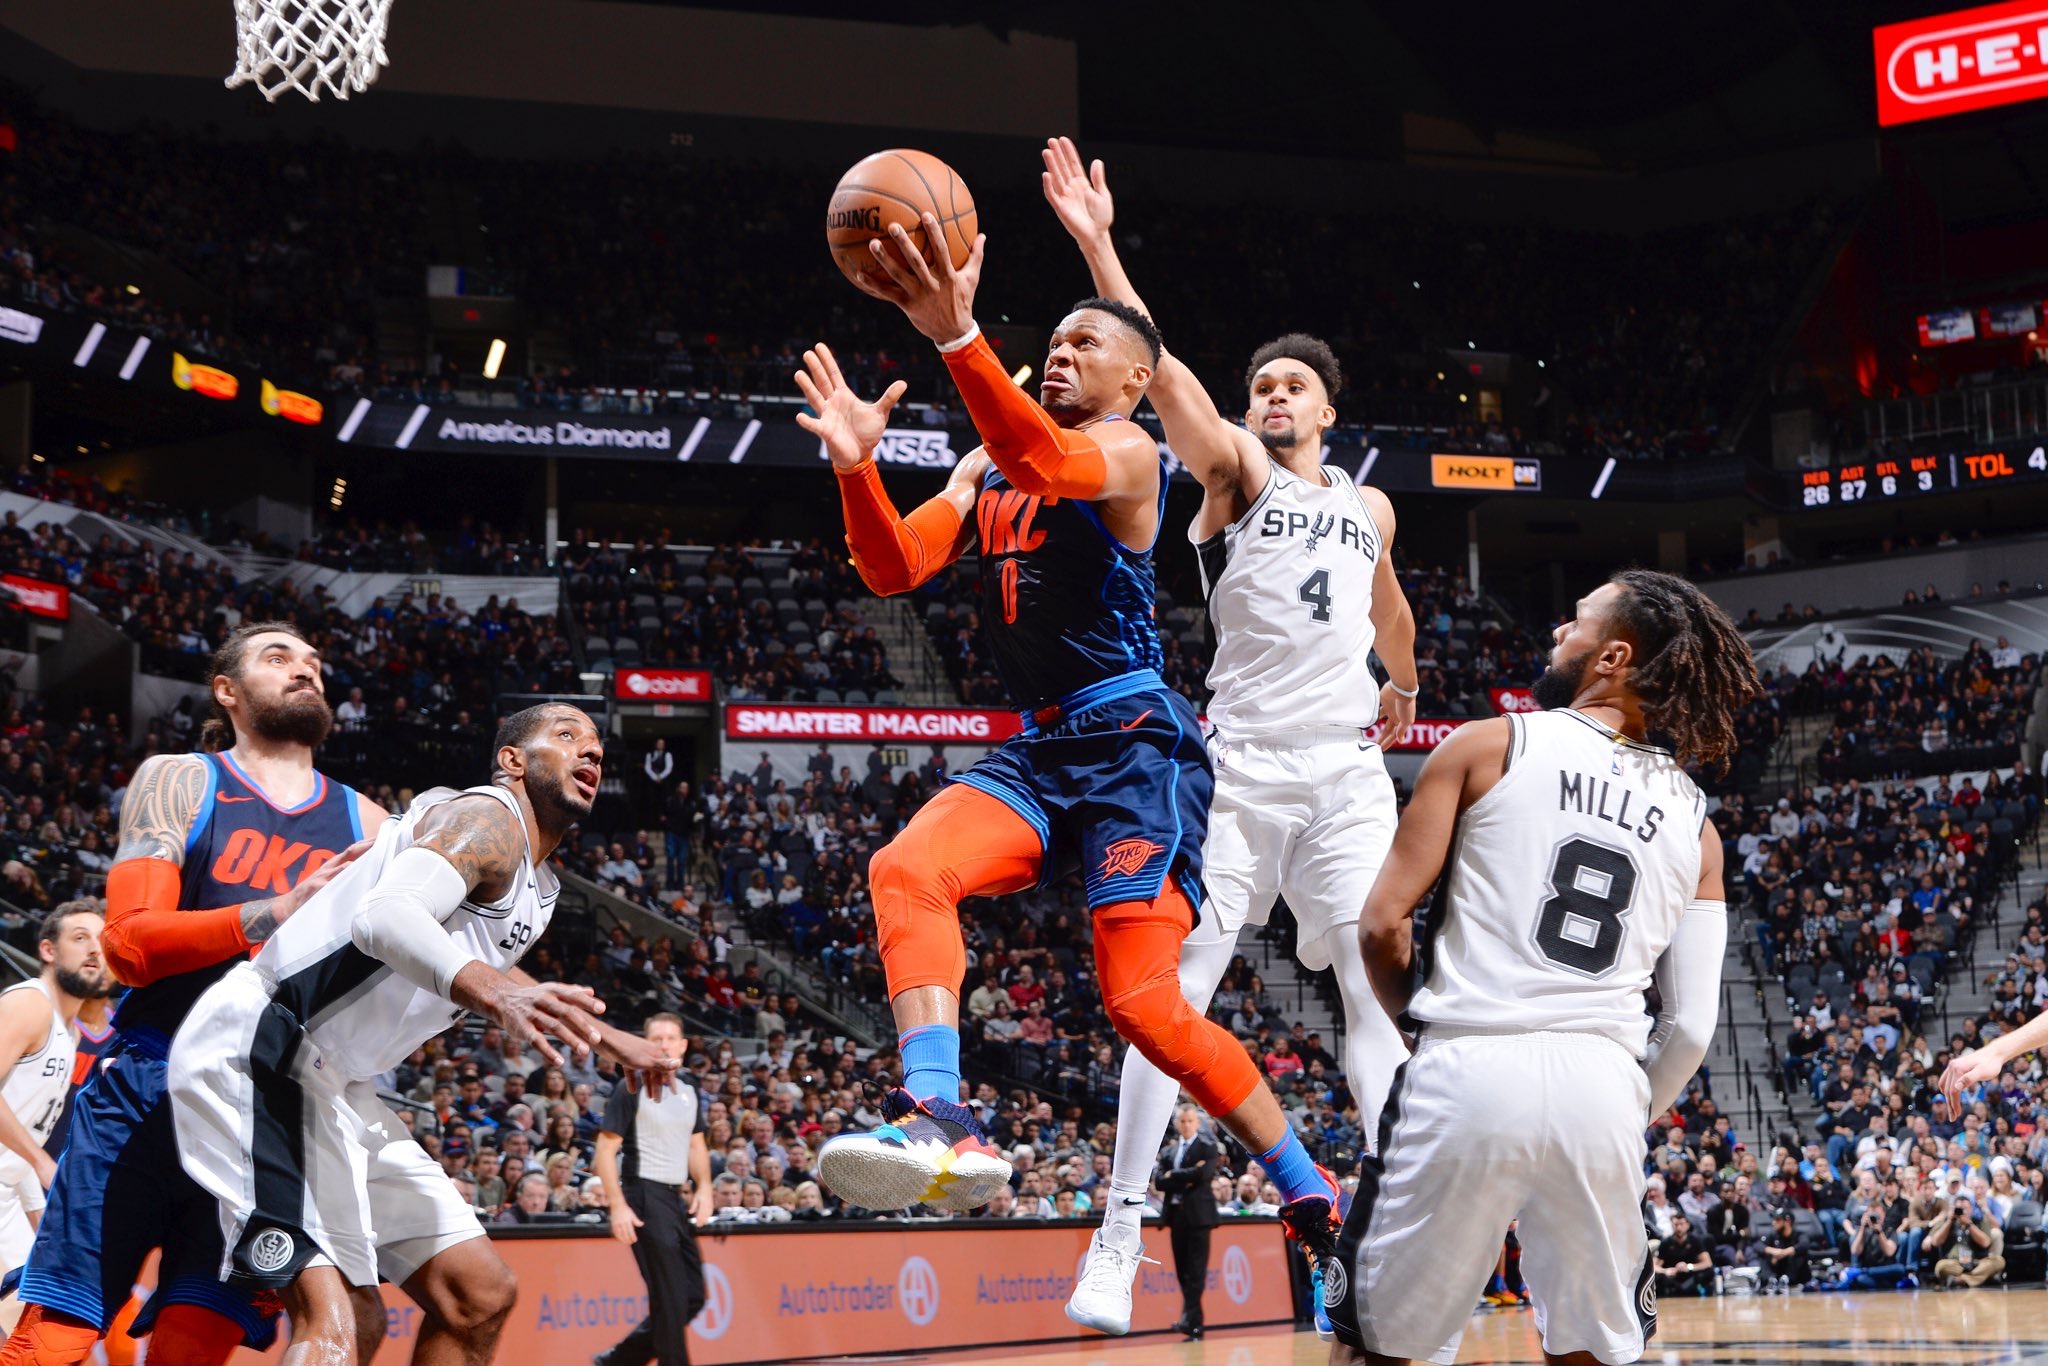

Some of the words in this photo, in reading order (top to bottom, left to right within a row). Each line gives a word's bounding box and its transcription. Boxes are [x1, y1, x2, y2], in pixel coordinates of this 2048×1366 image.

[438, 418, 554, 445] Americus
[556, 422, 671, 450] Diamond
[1447, 465, 1506, 479] HOLT
[1910, 456, 1937, 472] BLK
[1963, 452, 2015, 480] TOL
[2027, 446, 2047, 471] 4
[1803, 484, 1831, 506] 26
[1840, 479, 1867, 501] 27
[1881, 475, 1897, 496] 6
[1917, 471, 1933, 491] 3
[977, 489, 1060, 557] OKC
[1260, 509, 1375, 563] SPURS
[1001, 558, 1018, 625] 0
[1297, 566, 1334, 626] 4
[736, 710, 863, 734] SMARTER
[868, 712, 991, 737] IMAGING
[879, 749, 908, 766] 111
[1559, 769, 1665, 843] MILLS
[1109, 845, 1142, 869] OKC
[1528, 832, 1643, 981] 8
[778, 1277, 895, 1316] Autotrader
[975, 1268, 1073, 1304] Autotrader
[536, 1292, 649, 1331] Autotra
